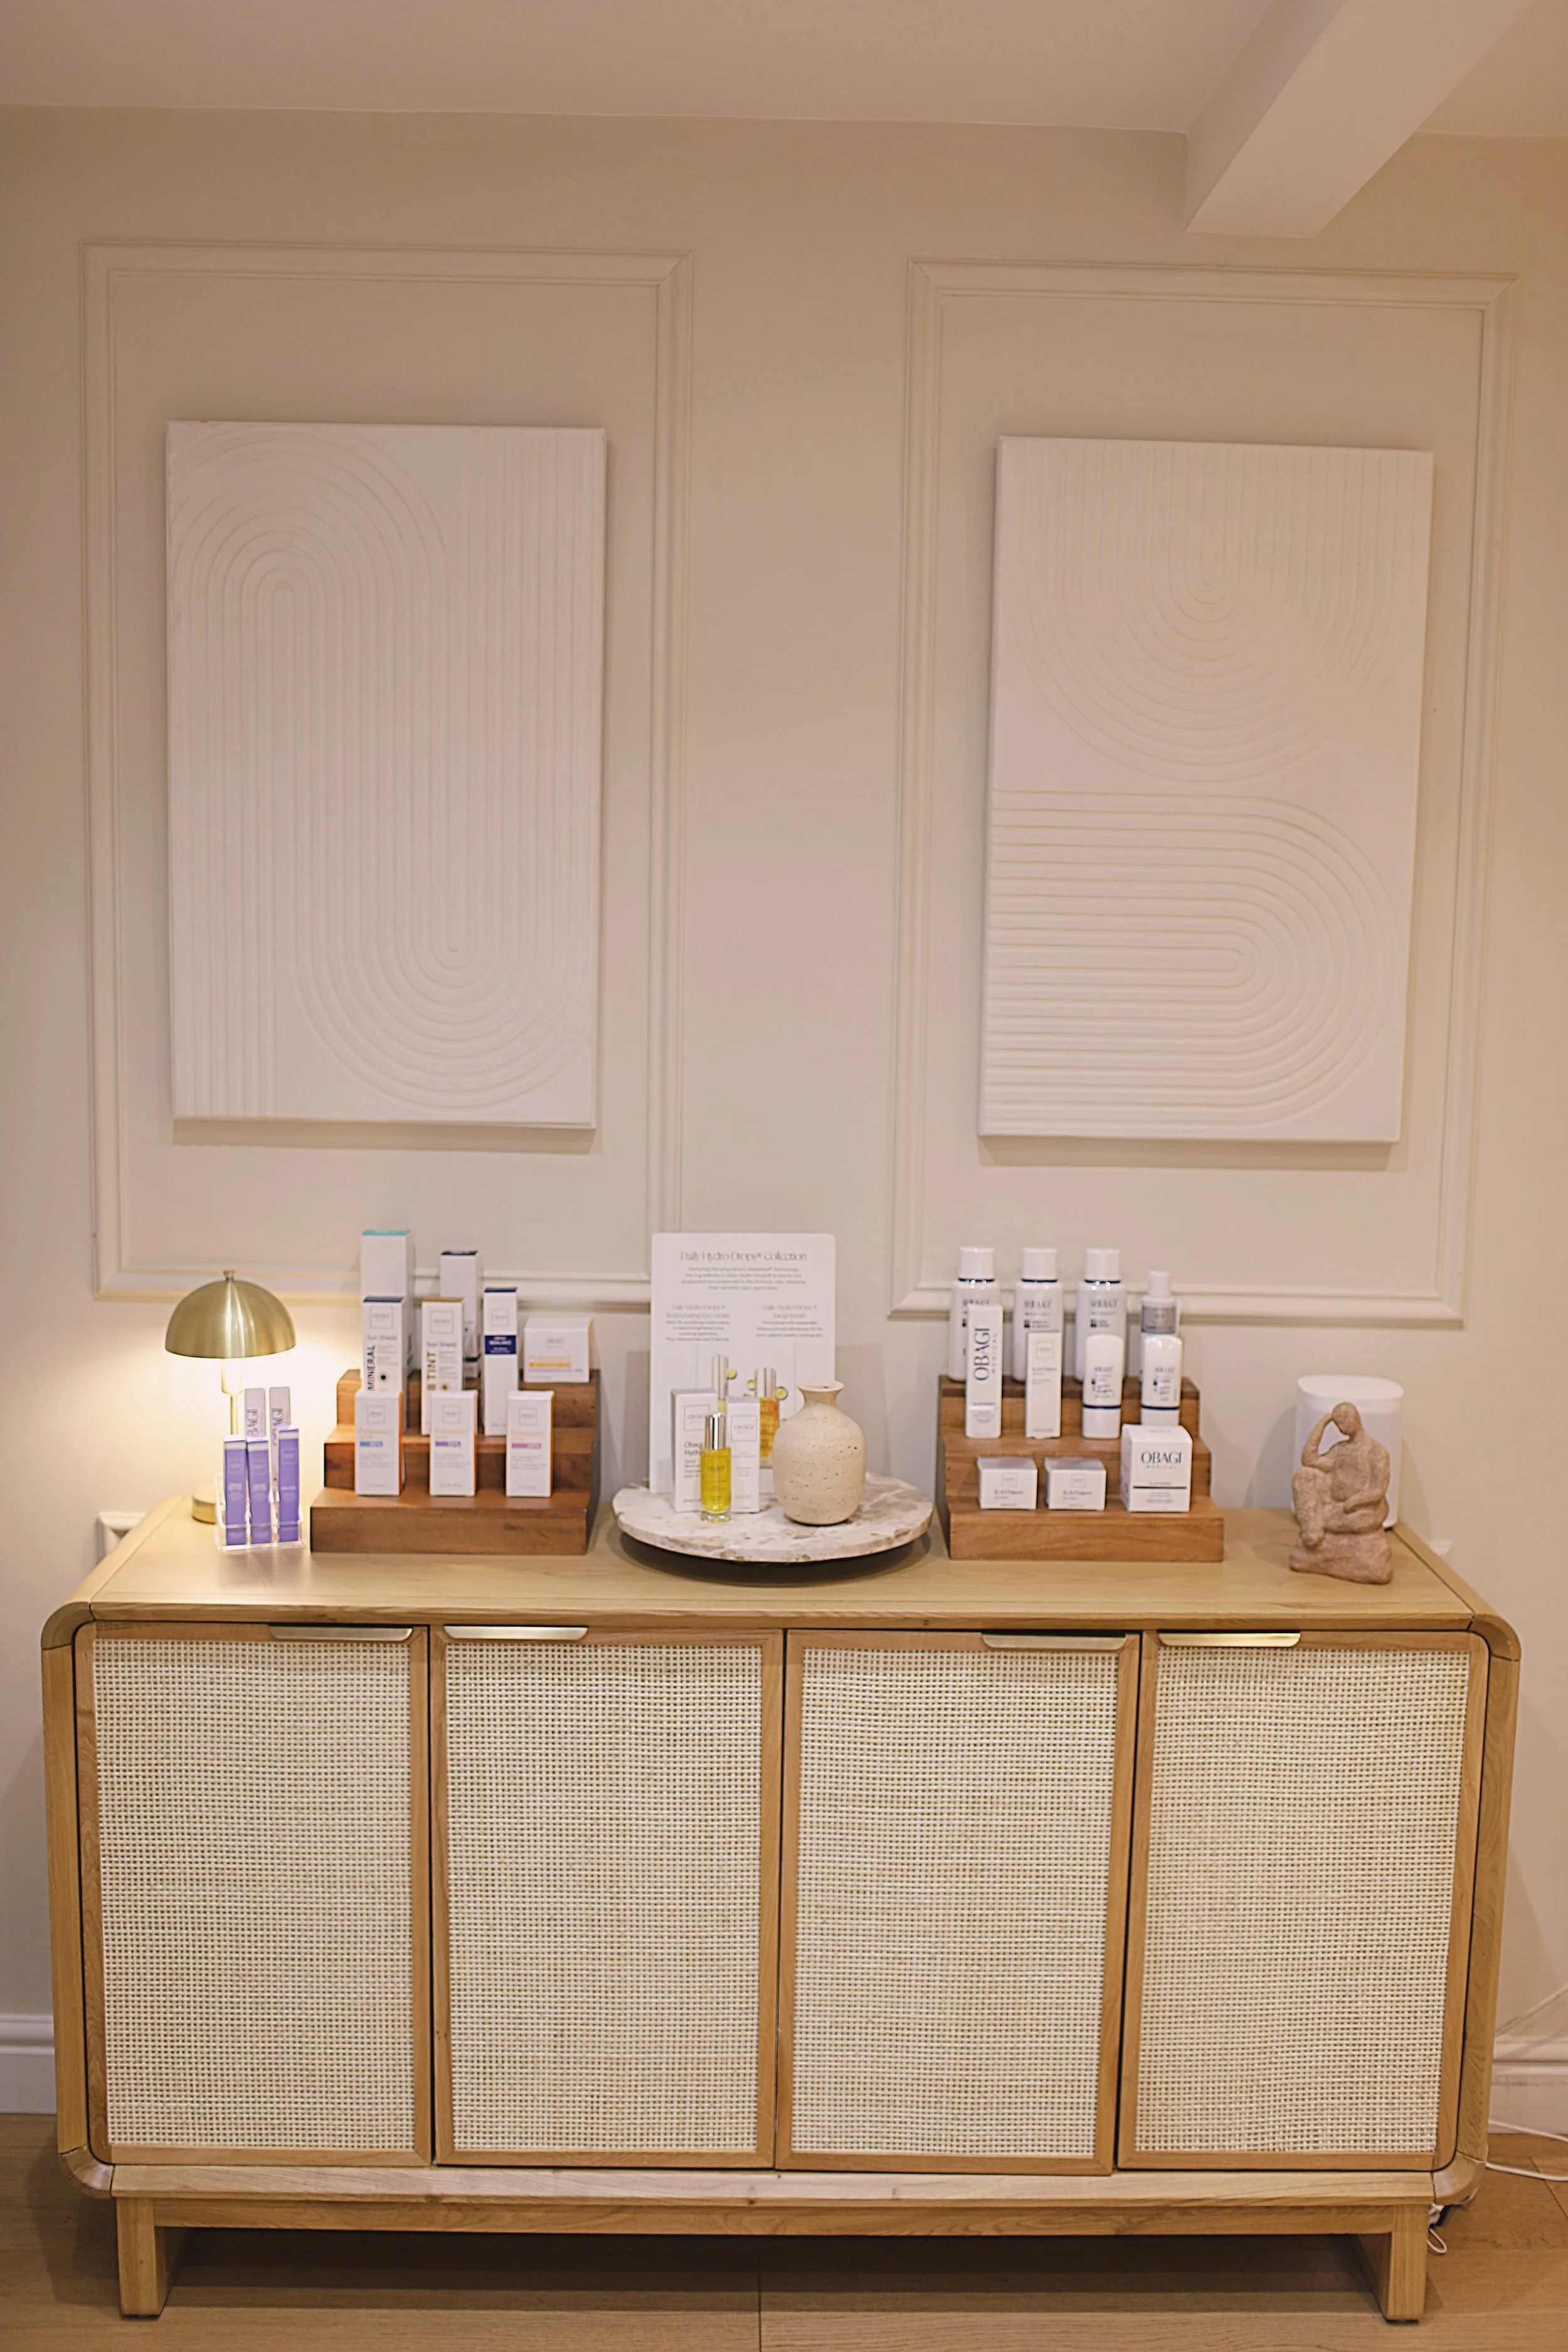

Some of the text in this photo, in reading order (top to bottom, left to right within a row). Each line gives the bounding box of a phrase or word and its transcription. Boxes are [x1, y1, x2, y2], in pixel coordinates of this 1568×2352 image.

[681, 1251, 701, 1262] Daily
[763, 1251, 807, 1261] Collection
[1024, 1300, 1052, 1308] OBAGI
[973, 1327, 991, 1381] OBAGI
[426, 1350, 436, 1380] TINT
[247, 1409, 258, 1436] BAGI
[1141, 1450, 1182, 1465] OBAGI
